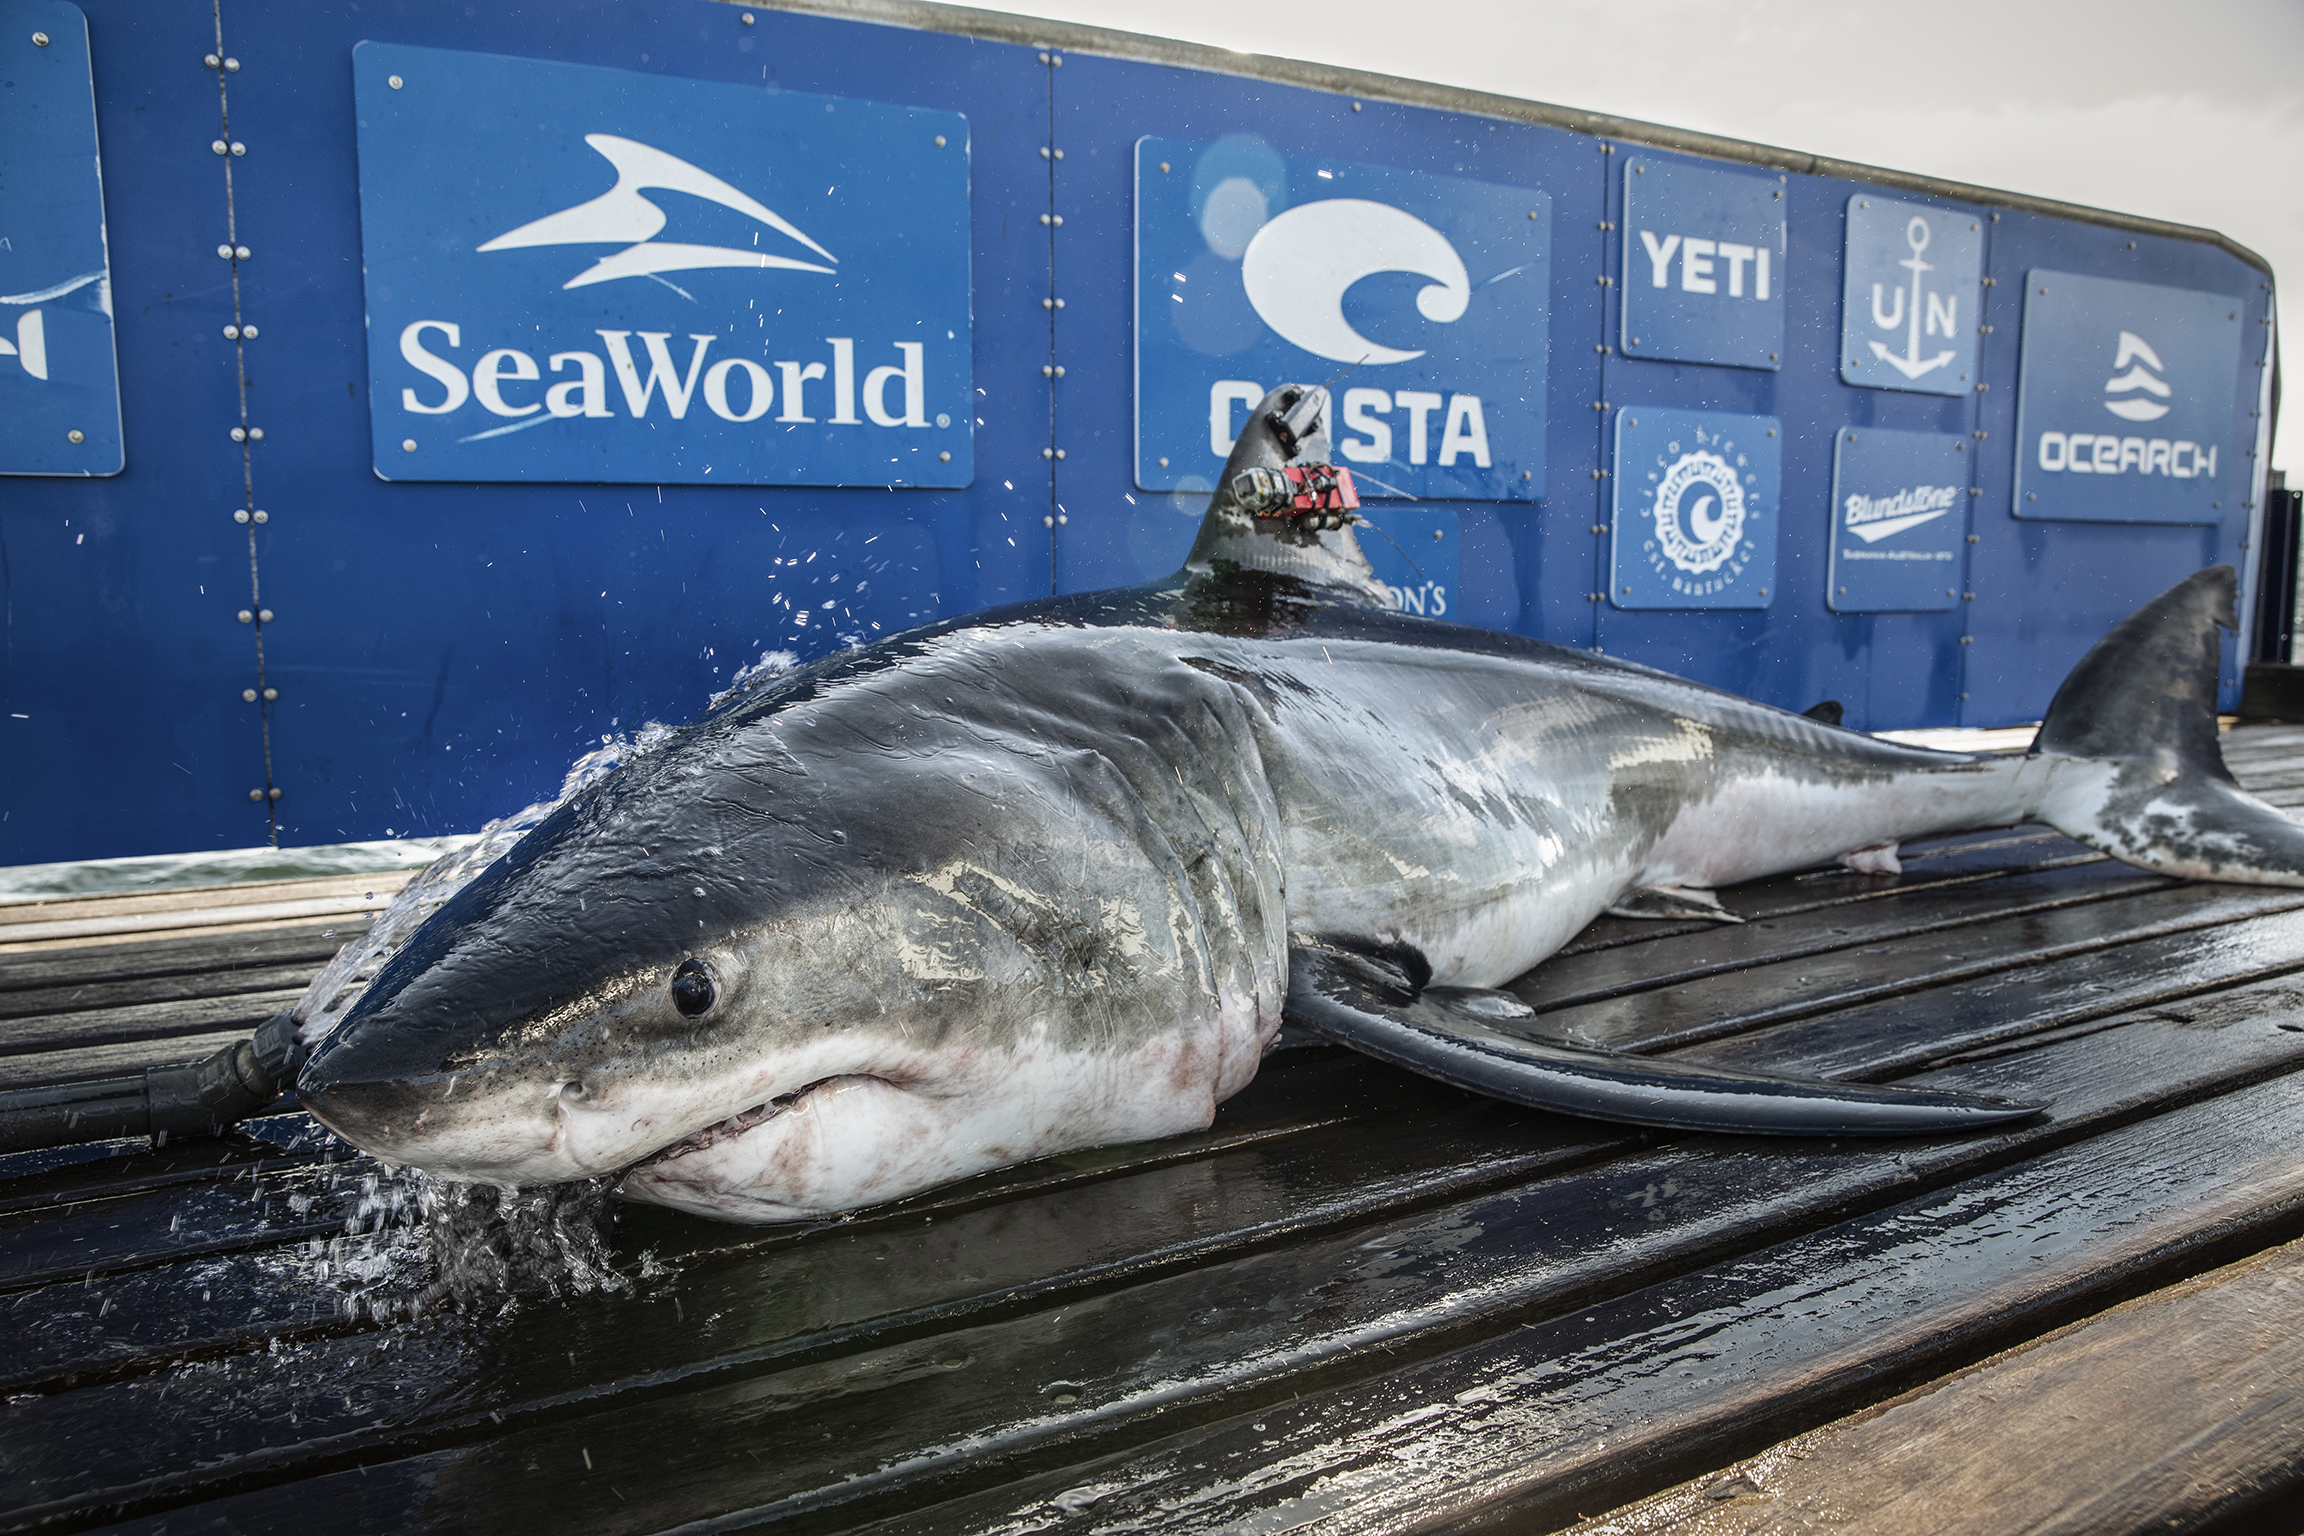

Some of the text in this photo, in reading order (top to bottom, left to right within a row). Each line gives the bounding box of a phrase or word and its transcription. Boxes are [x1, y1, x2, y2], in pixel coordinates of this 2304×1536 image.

[1639, 230, 1770, 300] YETI
[399, 319, 933, 429] SeaWorld
[1844, 485, 1957, 526] Blundstone
